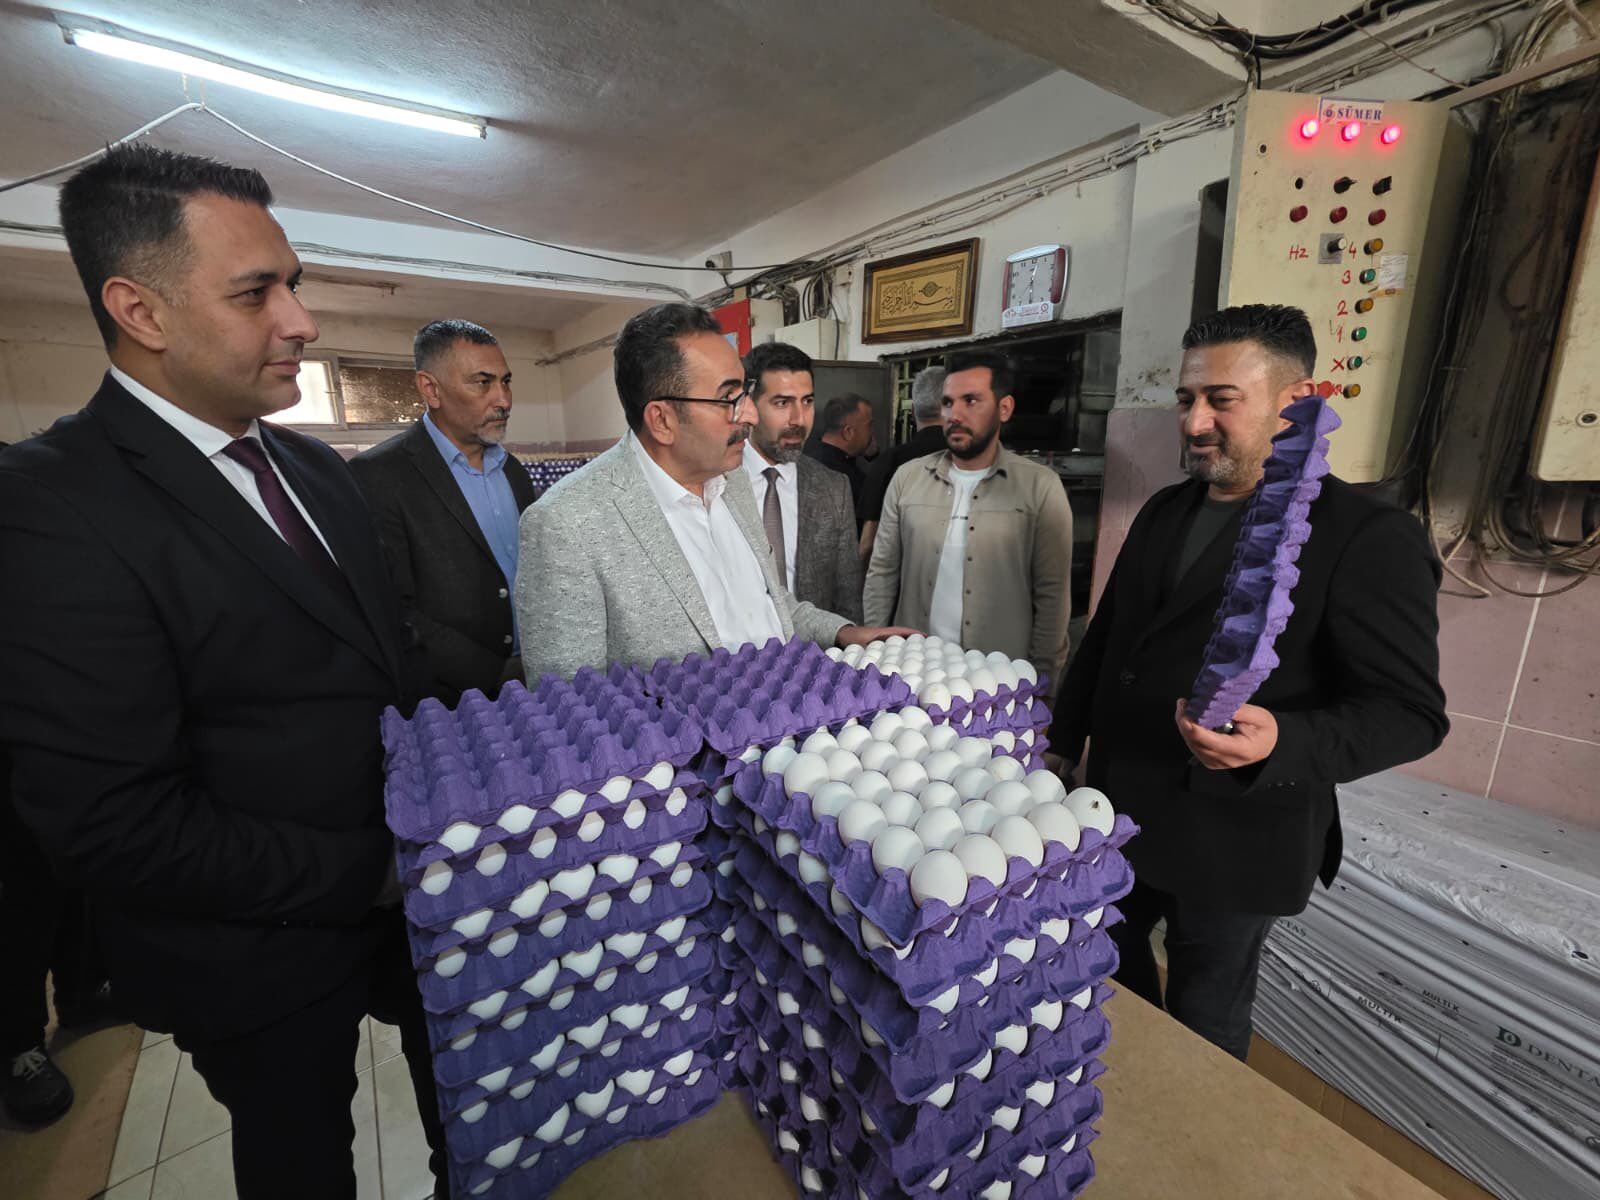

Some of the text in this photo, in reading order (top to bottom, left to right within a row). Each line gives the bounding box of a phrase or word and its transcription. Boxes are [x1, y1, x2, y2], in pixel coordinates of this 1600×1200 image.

[1338, 105, 1382, 120] SÜMER
[1349, 241, 1357, 259] 4
[1341, 270, 1351, 284] 3
[1337, 300, 1348, 316] 2
